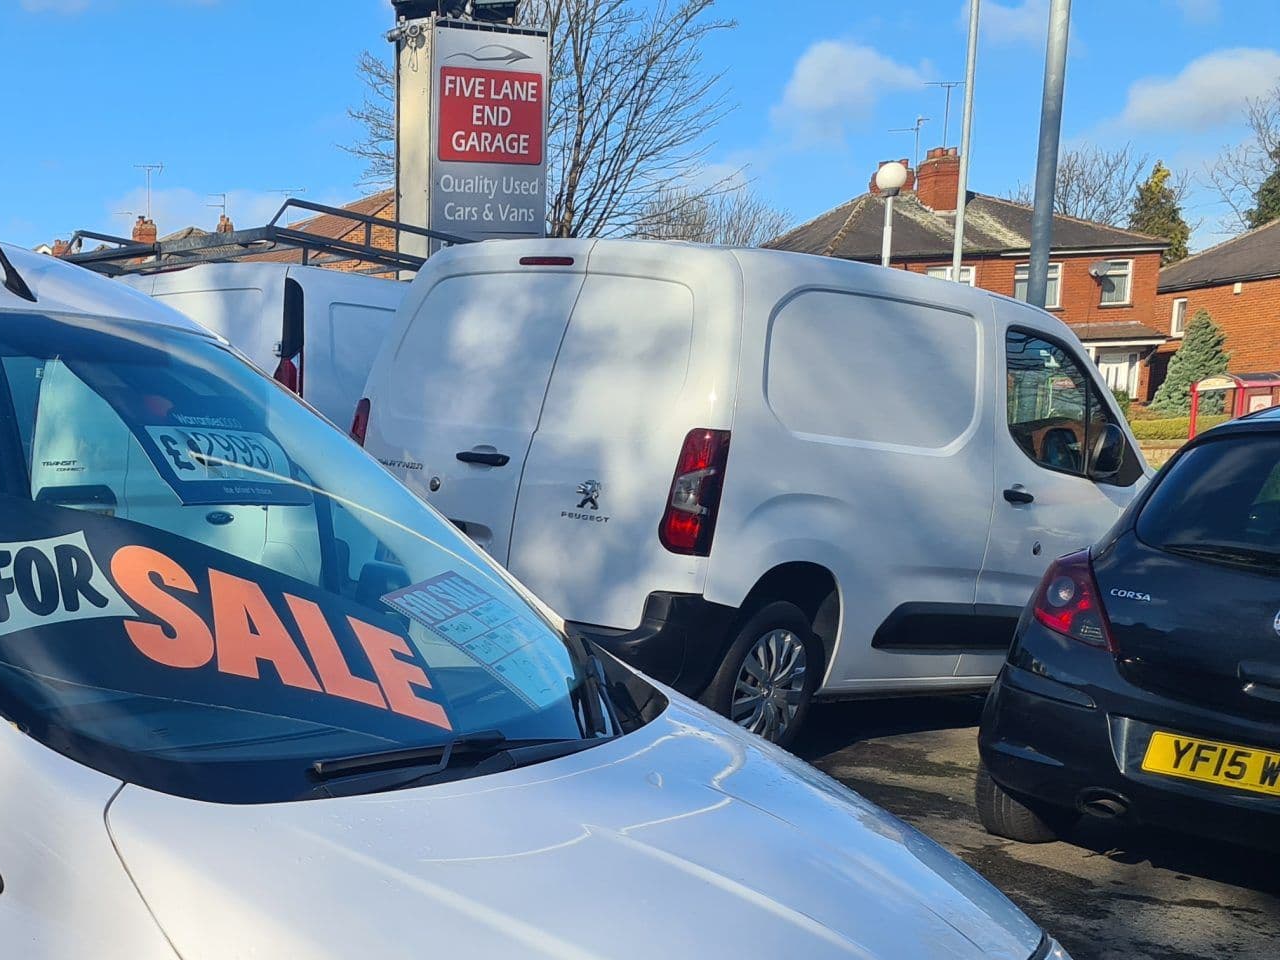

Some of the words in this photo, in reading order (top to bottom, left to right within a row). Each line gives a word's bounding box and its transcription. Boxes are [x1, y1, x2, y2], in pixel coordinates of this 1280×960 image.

[445, 75, 485, 98] FIVE
[490, 79, 538, 102] LANE
[472, 105, 511, 127] END
[452, 131, 530, 155] GARAGE
[440, 174, 498, 199] Quality
[502, 176, 539, 195] Used
[444, 202, 478, 221] Cars
[482, 203, 494, 221] &
[498, 204, 535, 222] Vans
[560, 511, 610, 523] PEUGEOT
[1110, 588, 1152, 602] CORSA
[110, 545, 453, 731] SALE
[1172, 739, 1252, 781] YF15
